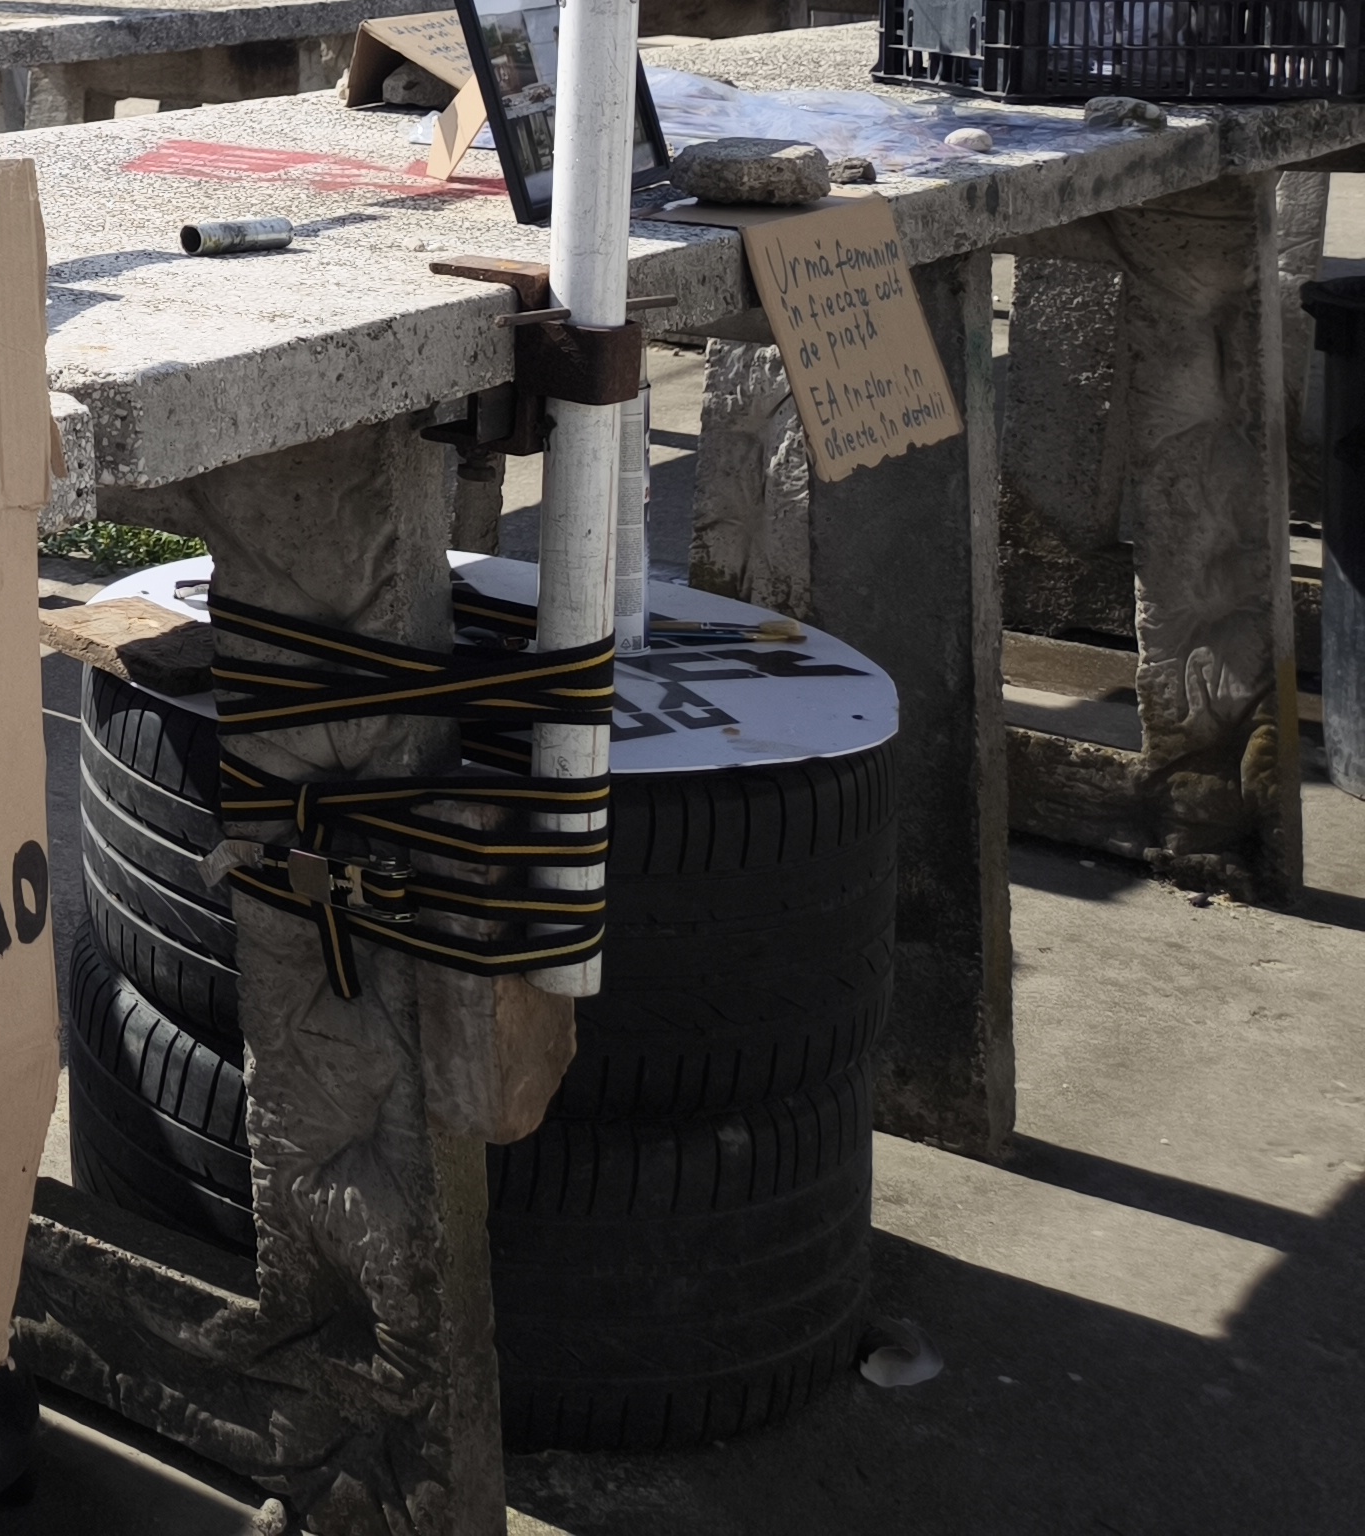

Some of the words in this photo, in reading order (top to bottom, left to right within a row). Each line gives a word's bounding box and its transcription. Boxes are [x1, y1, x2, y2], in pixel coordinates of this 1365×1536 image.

[765, 237, 834, 295] Urmă
[808, 287, 870, 332] fiecare
[799, 339, 821, 370] de
[809, 378, 843, 426] EA
